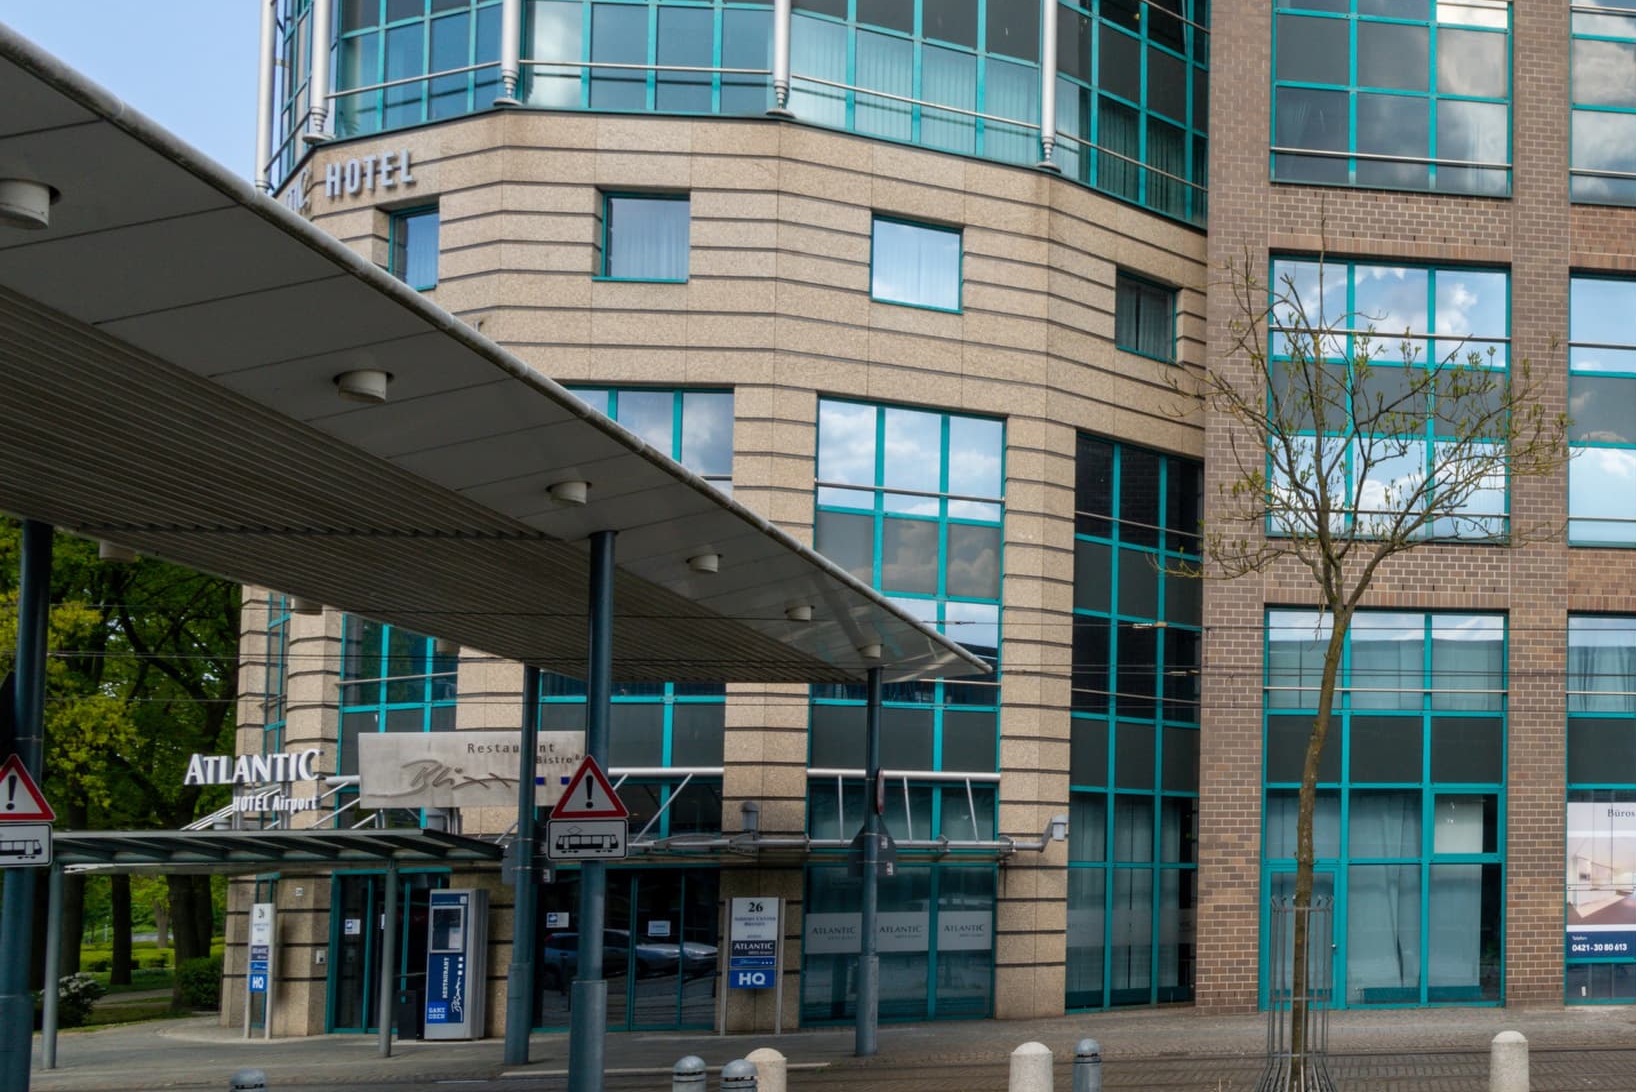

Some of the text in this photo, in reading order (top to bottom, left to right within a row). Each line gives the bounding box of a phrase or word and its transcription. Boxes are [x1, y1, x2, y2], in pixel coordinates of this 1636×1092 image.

[325, 148, 415, 197] HOTEL
[467, 742, 555, 754] Restaunt
[184, 748, 321, 785] ATLANTIC
[232, 794, 318, 816] HOTEL Airport
[1607, 807, 1636, 818] Büros
[748, 901, 764, 913] 26
[879, 925, 922, 934] ATLANTIC
[943, 923, 985, 933] ATLANTIC
[734, 942, 774, 951] ATLANTIC
[251, 975, 265, 989] HQ
[738, 972, 766, 986] HQ
